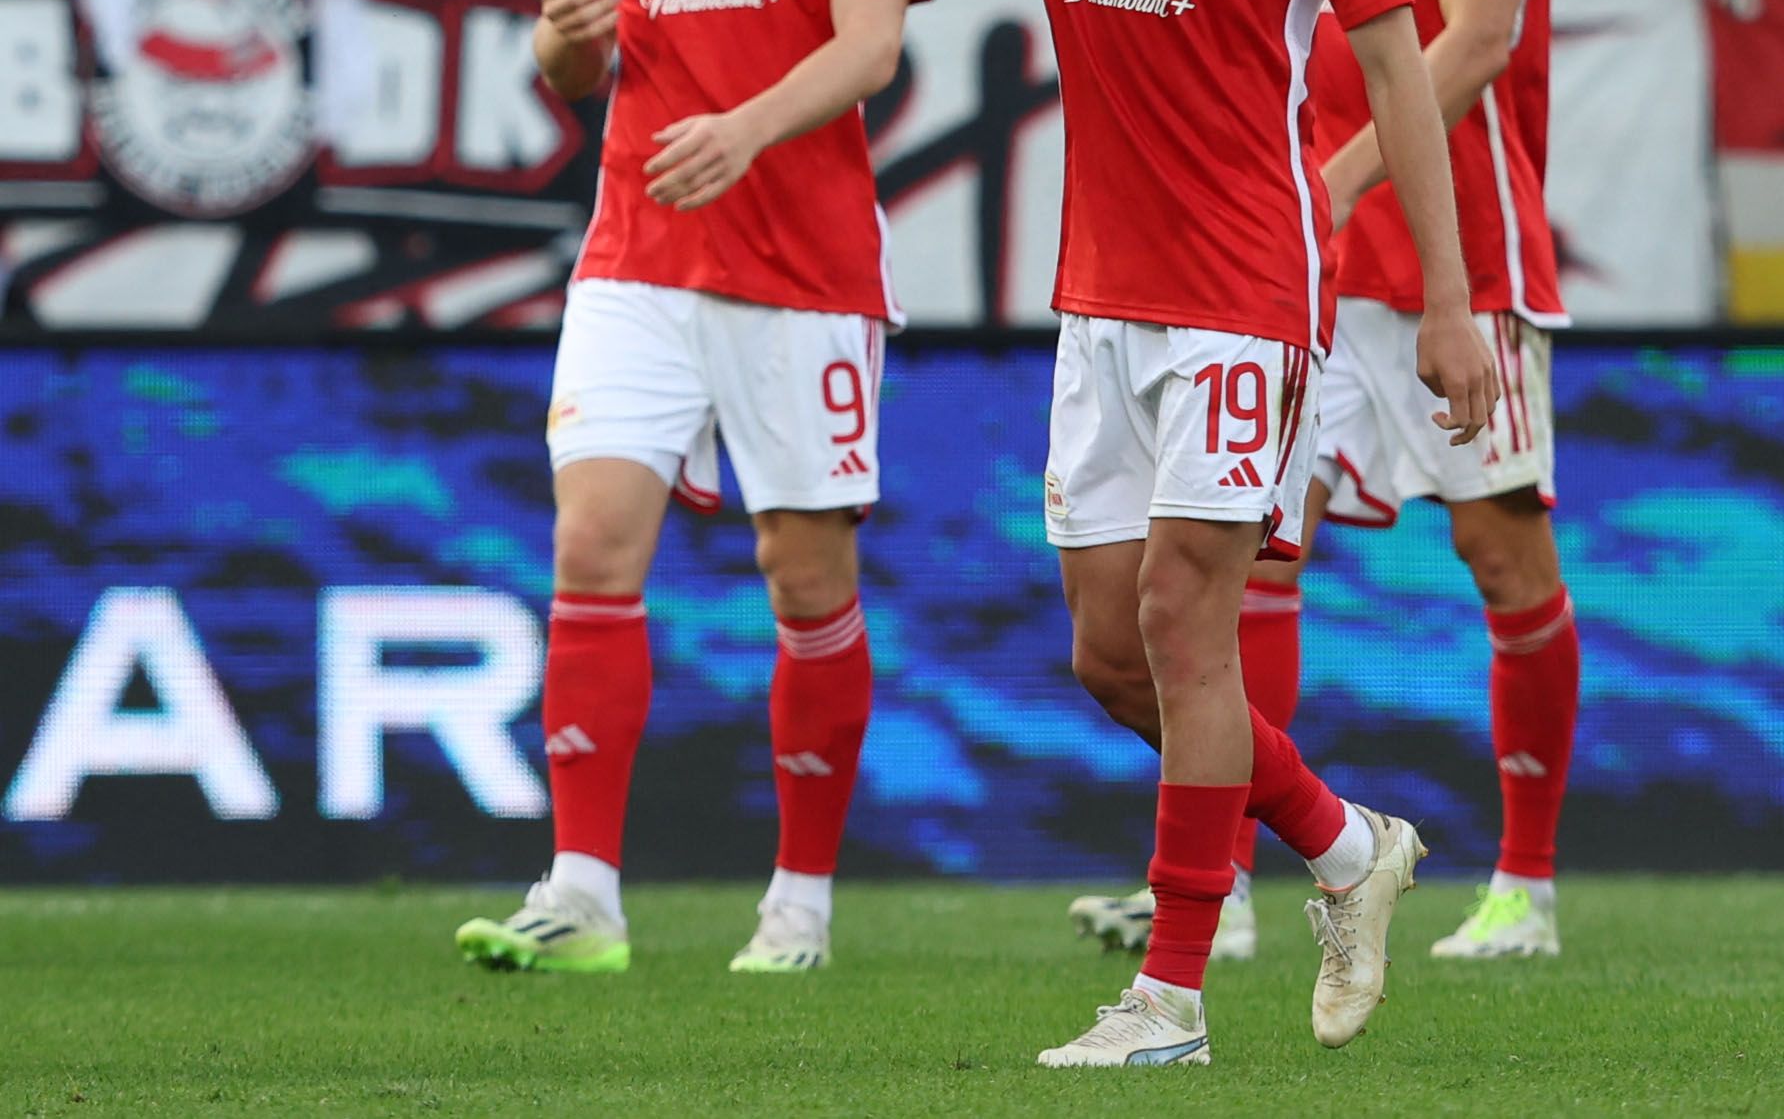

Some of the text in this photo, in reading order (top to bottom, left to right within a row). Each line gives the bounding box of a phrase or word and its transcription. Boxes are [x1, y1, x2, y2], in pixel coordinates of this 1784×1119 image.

[822, 359, 866, 445] 9
[1194, 361, 1268, 454] 19
[3, 585, 549, 822] AR
